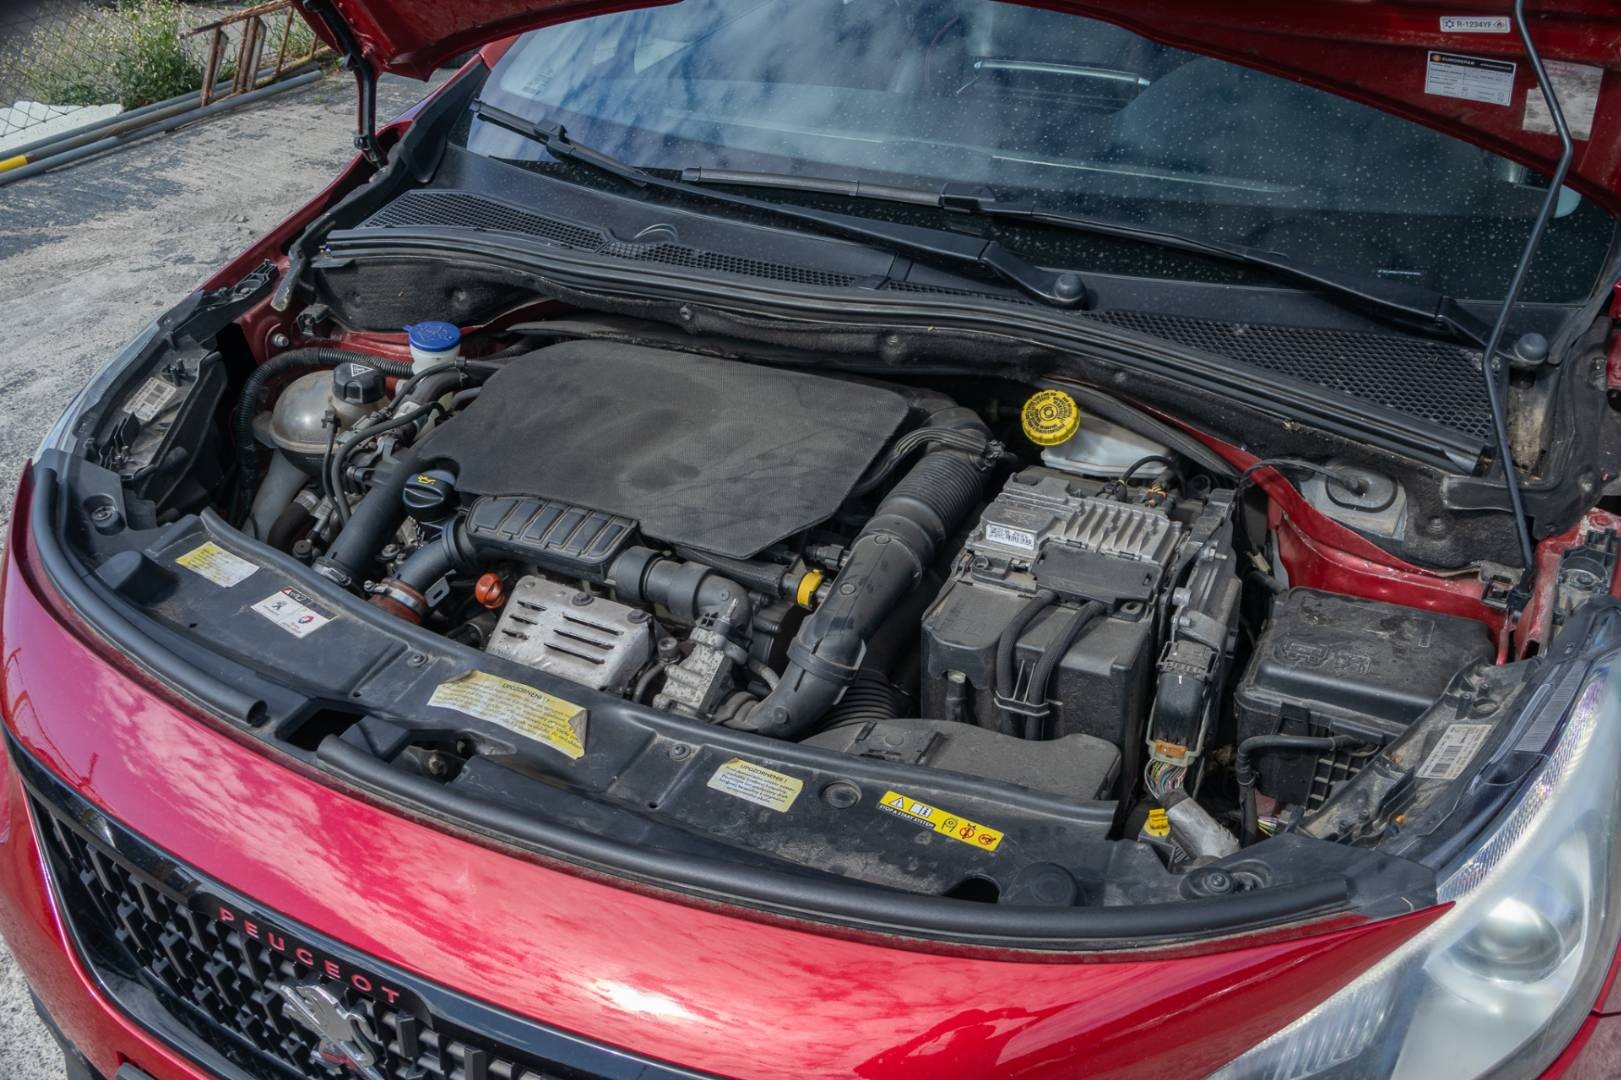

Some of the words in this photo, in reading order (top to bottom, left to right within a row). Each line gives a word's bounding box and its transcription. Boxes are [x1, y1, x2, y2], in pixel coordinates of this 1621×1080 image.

[880, 804, 893, 813] STOP
[898, 811, 914, 821] START
[914, 817, 934, 828] SYSTEM
[218, 906, 400, 1004] PEUGEOT
